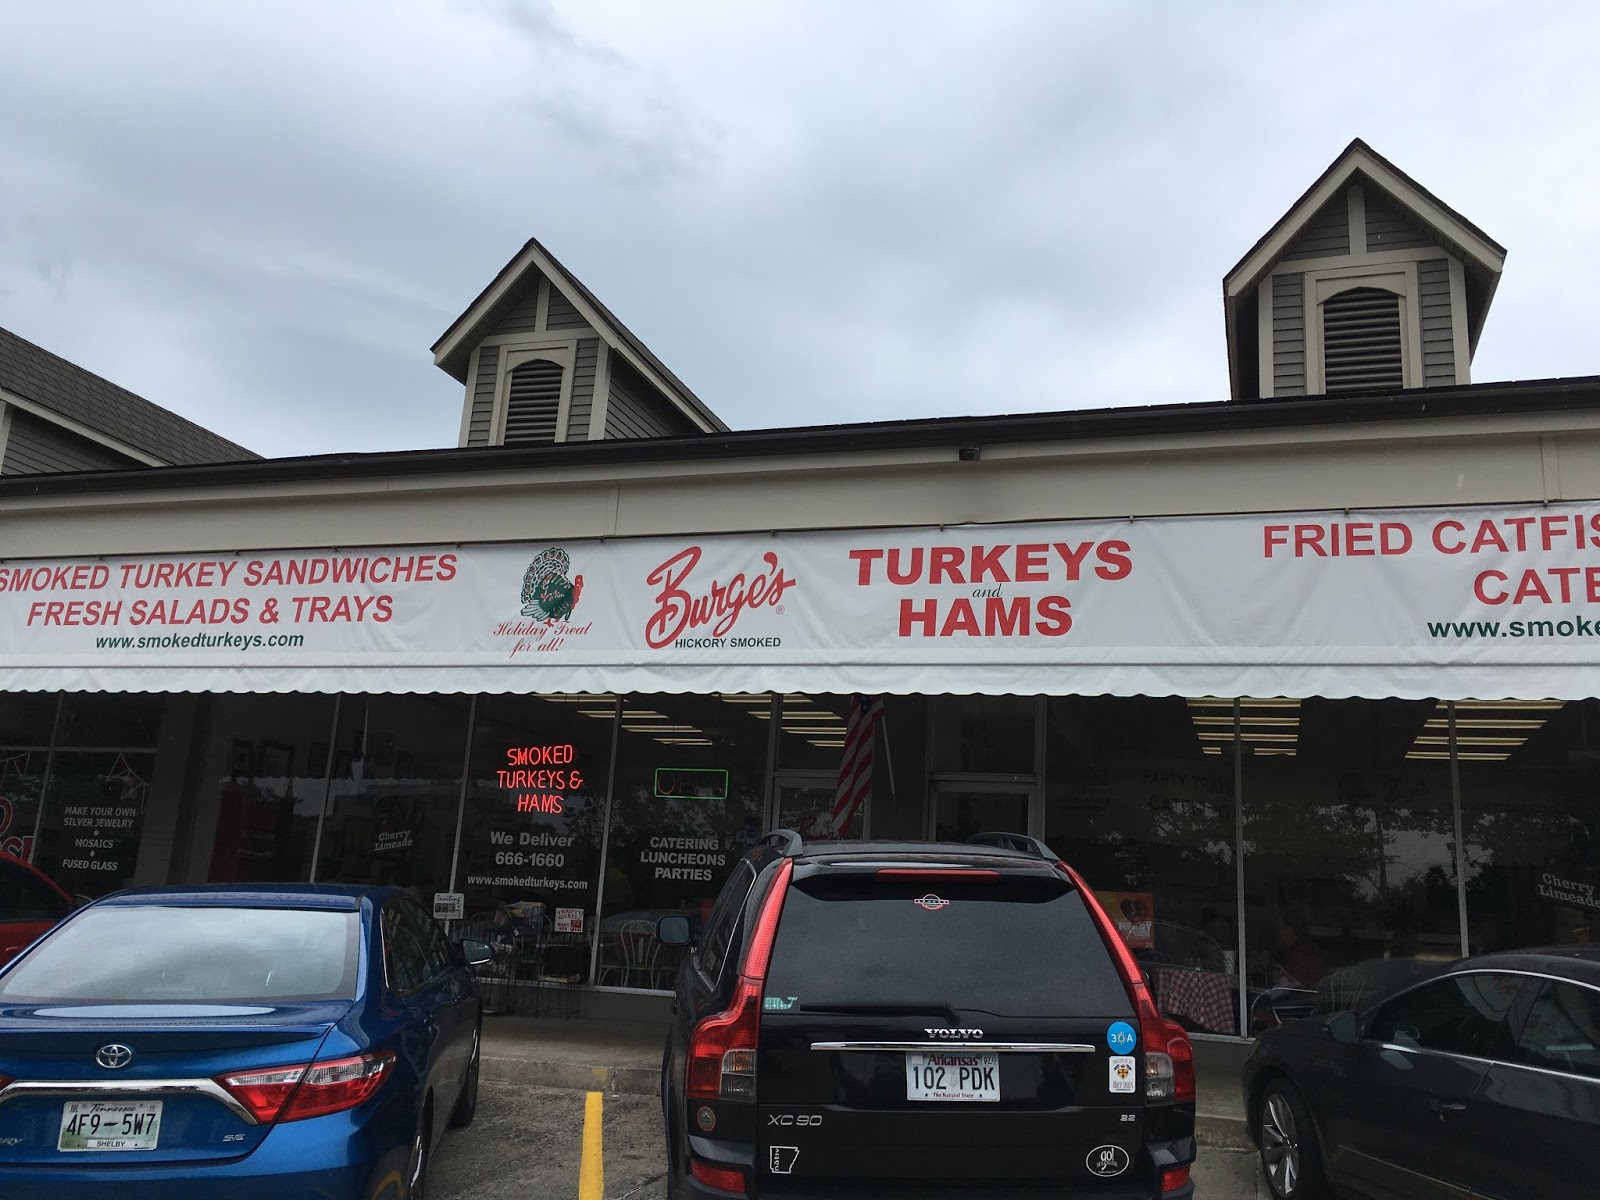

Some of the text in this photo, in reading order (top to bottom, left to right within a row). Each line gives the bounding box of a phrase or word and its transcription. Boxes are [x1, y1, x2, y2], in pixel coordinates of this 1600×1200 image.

[1263, 522, 1413, 557] FRIED
[849, 540, 1132, 586] TURKEYS
[0, 554, 458, 592] SMOKED TURKEY SANDWICHES
[645, 546, 796, 649] Burge's
[972, 583, 1002, 598] and
[27, 595, 394, 626] FRESH SALADS & TRAYS
[899, 595, 1073, 637] HAMS
[493, 621, 549, 637] Holiday
[95, 632, 304, 651] www.smokedturkeys.com
[509, 637, 564, 658] for all!
[675, 637, 781, 649] HICKORY SMOKED
[507, 744, 574, 767] SMOKED
[497, 770, 584, 790] TURKEYS &
[64, 806, 136, 817] MAKE YOUR OWN
[517, 794, 564, 814] HAMS
[63, 817, 134, 829] SILVER JEWELRY
[75, 839, 114, 849] MOSAICS
[378, 830, 410, 842] Cherry
[490, 831, 575, 847] We Deliver
[650, 837, 719, 851] CATERING
[373, 838, 413, 852] Limeade
[62, 859, 118, 871] FUSED GLASS
[495, 852, 565, 868] 666-1660
[640, 851, 726, 867] LUNCHEONS
[655, 867, 713, 881] PARTIES
[467, 875, 588, 891] www.smokedturkeys.com
[1542, 873, 1595, 897] Cherry
[1538, 884, 1600, 909] Limeade
[924, 1028, 984, 1039] VOLVO
[1111, 1031, 1134, 1045] 30A
[928, 1053, 978, 1066] Arkansas
[914, 1066, 995, 1091] 102 PDK
[90, 1103, 136, 1114] Tennessee
